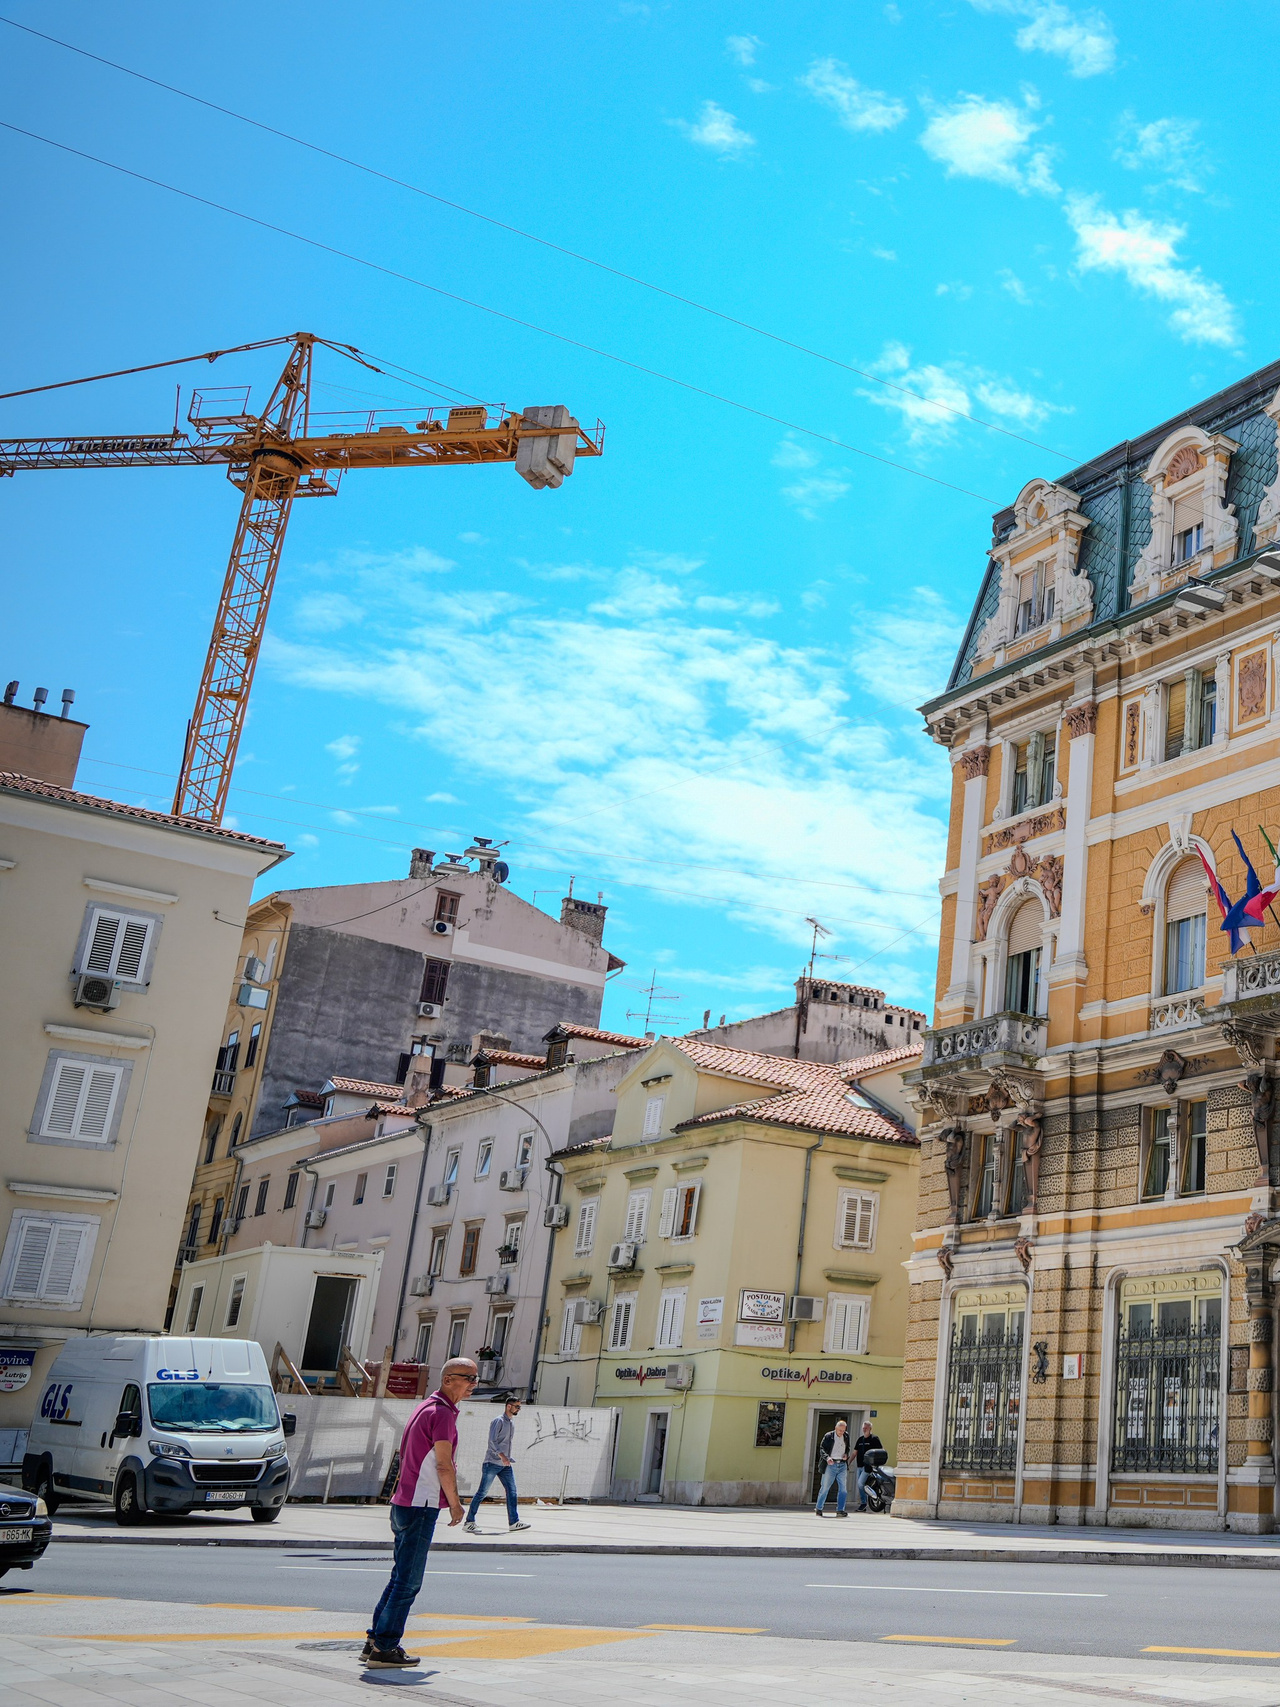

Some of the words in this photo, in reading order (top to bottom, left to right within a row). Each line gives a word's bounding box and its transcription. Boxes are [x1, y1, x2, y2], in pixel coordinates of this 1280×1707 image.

[746, 1293, 781, 1303] POSTOLAR
[0, 1354, 29, 1365] ovine
[4, 1371, 28, 1379] Lutrija
[156, 1368, 199, 1380] GLS
[615, 1367, 637, 1379] Optika
[646, 1366, 666, 1377] Dabra
[761, 1367, 800, 1379] Optika
[819, 1370, 853, 1381] Dabra
[41, 1383, 73, 1419] GLS
